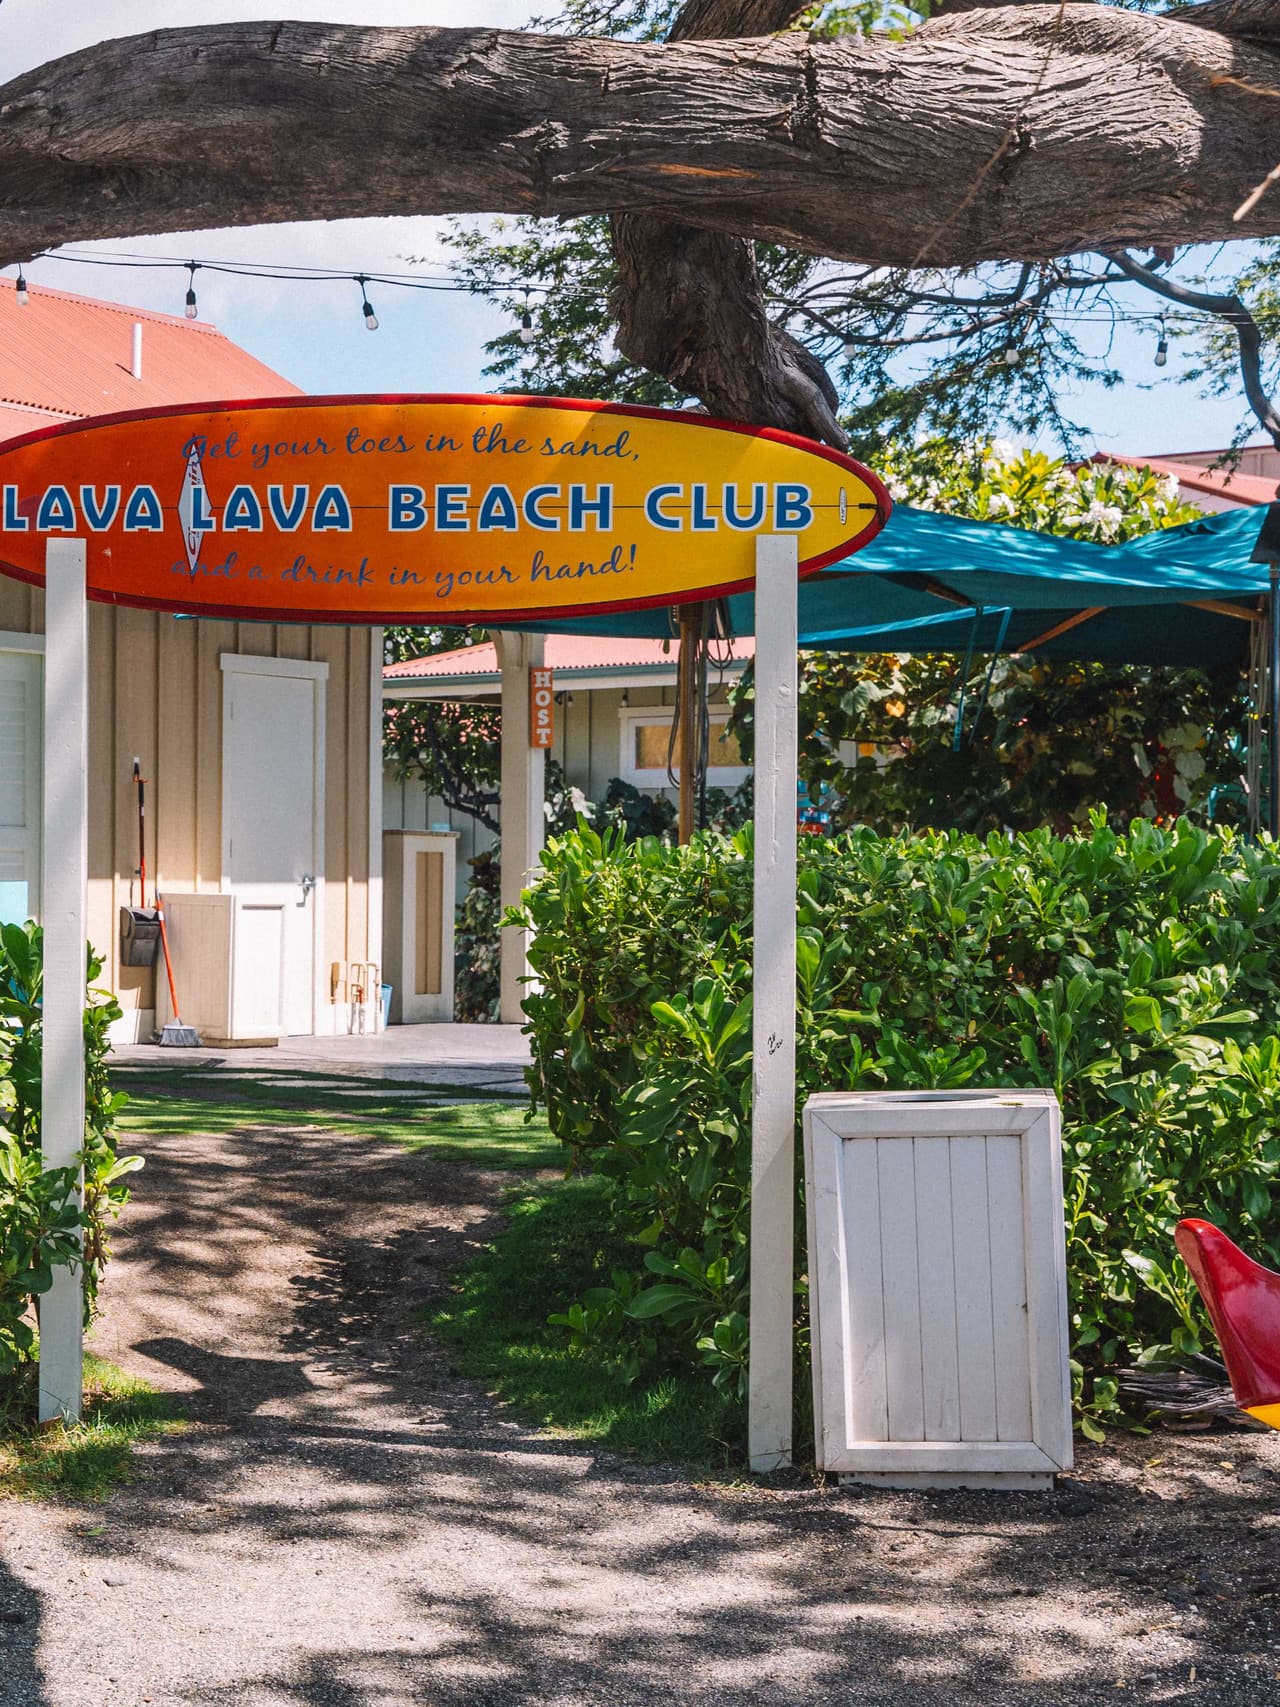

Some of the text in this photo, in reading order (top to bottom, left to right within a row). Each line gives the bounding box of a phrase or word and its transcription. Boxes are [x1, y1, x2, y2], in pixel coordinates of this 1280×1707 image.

[182, 423, 639, 469] Get your toes in the sand,
[3, 485, 164, 532] LAVA
[190, 485, 353, 532] LAVA
[389, 484, 614, 532] BEACH
[644, 482, 814, 532] CLUB
[172, 544, 637, 598] and a drink in your hand!
[534, 671, 551, 745] HOST
